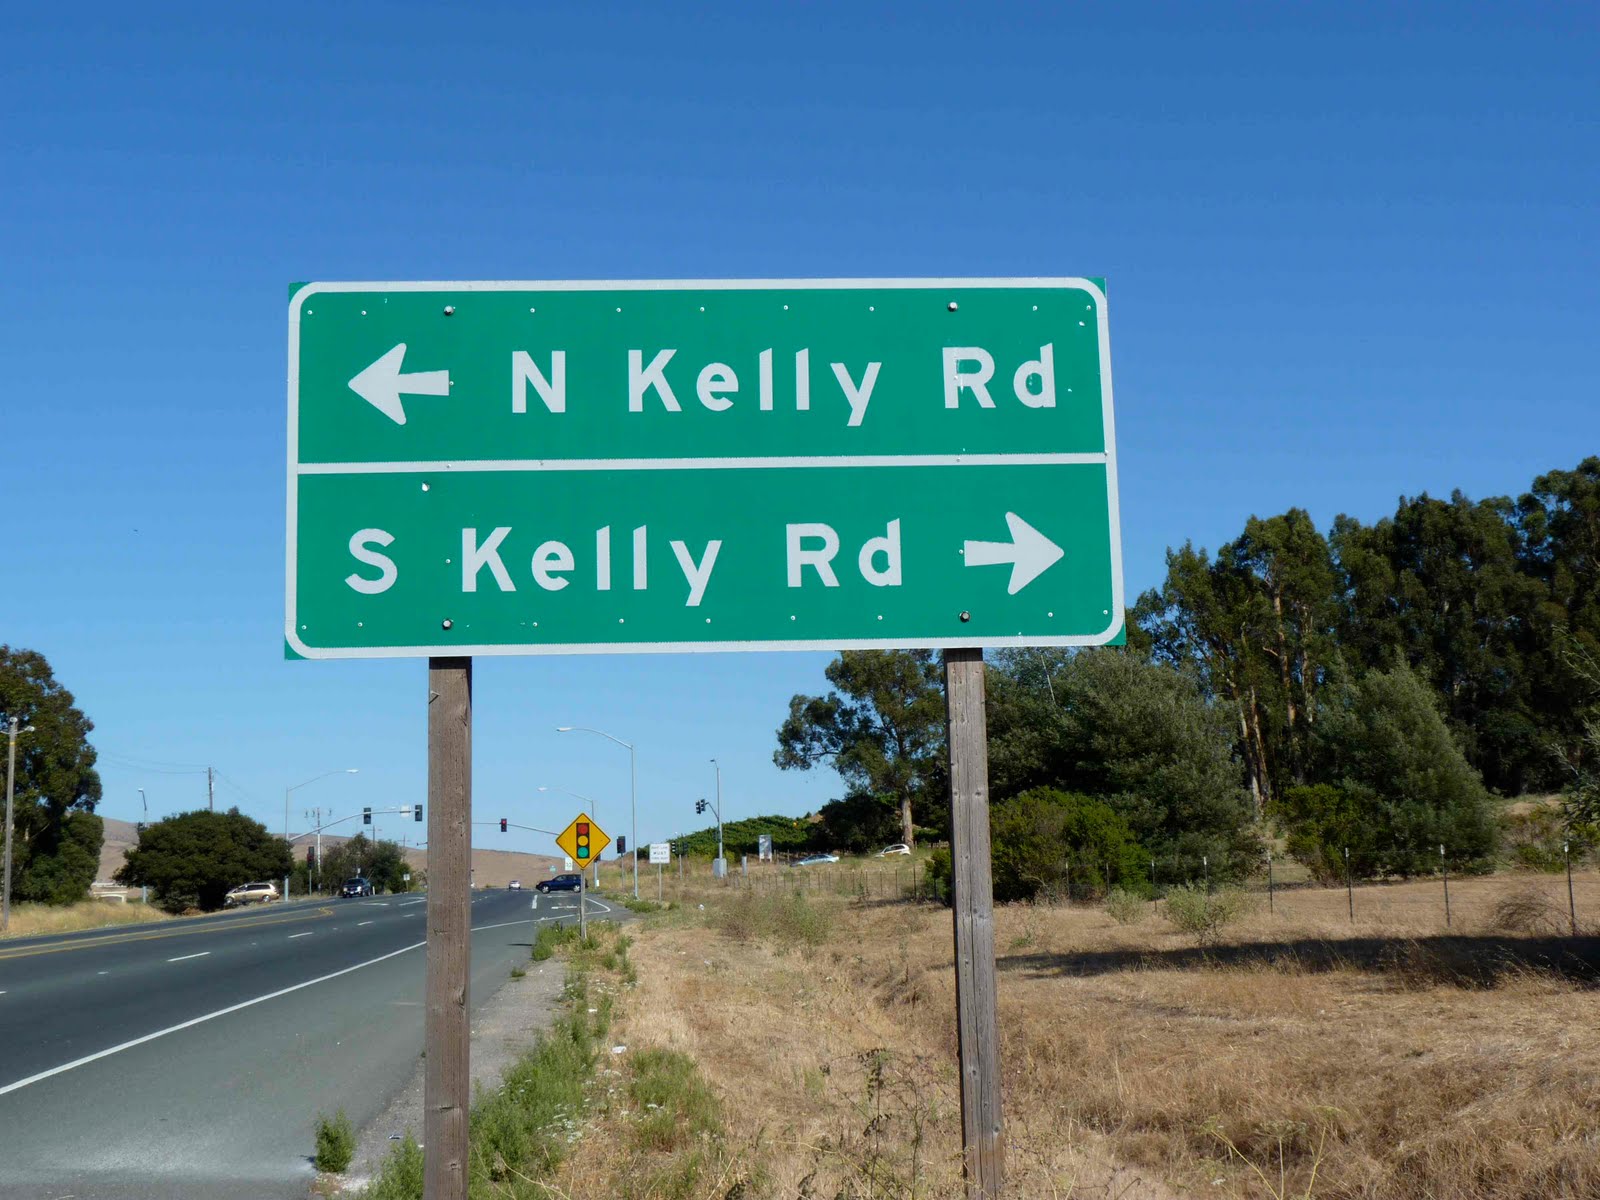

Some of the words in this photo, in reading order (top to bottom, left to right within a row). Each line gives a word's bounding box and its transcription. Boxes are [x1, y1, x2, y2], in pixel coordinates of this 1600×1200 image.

[511, 350, 566, 413] N
[628, 348, 882, 427] Kelly
[942, 343, 1056, 409] Rd
[345, 528, 398, 595] S
[462, 525, 723, 607] Kelly
[786, 518, 903, 588] Rd
